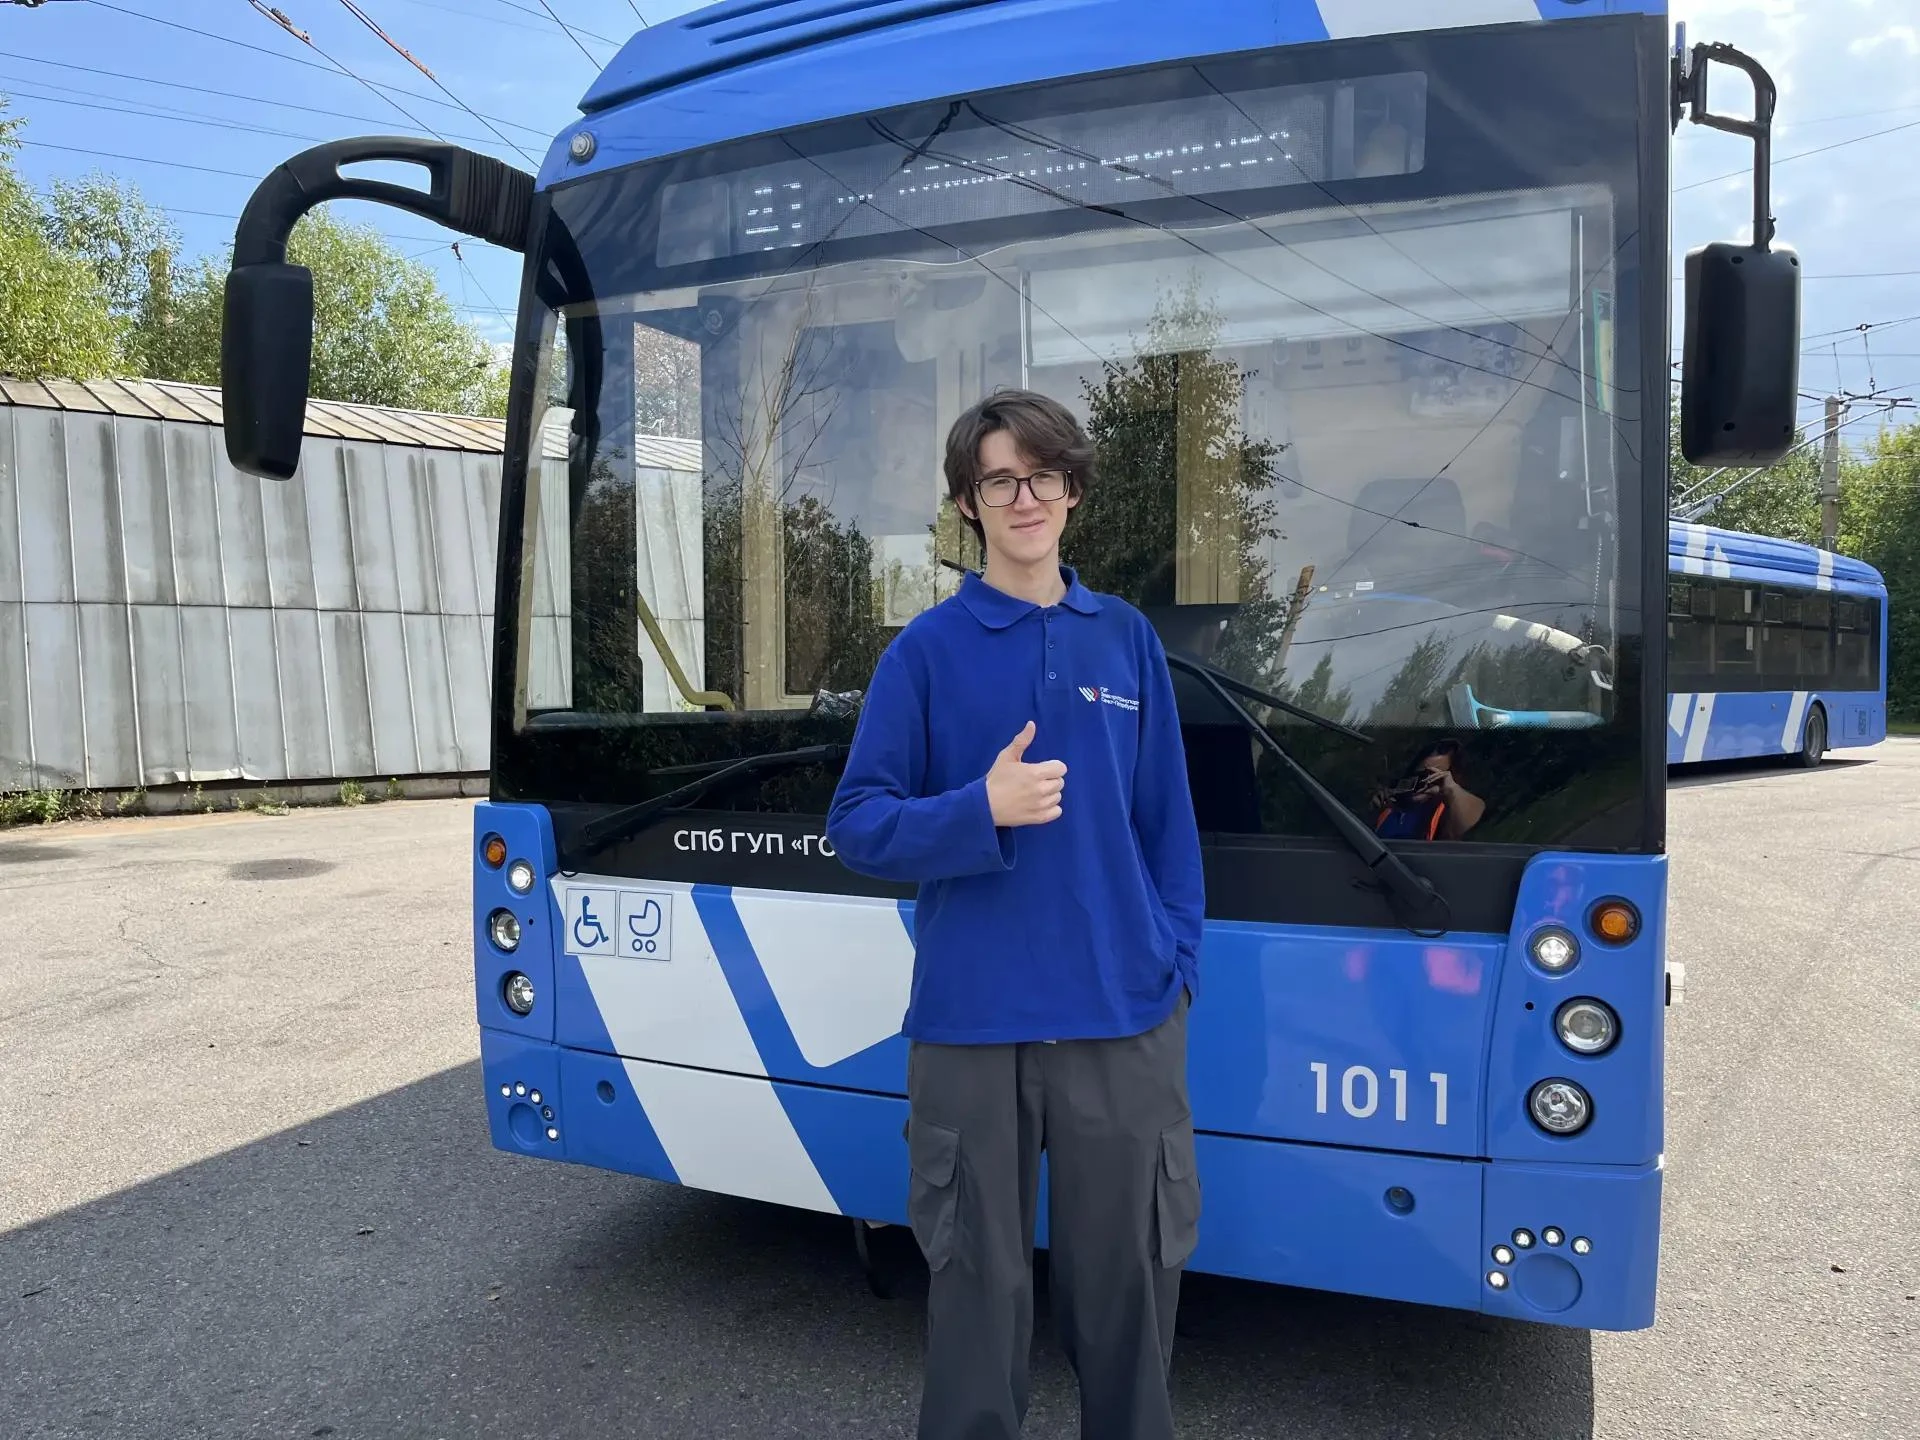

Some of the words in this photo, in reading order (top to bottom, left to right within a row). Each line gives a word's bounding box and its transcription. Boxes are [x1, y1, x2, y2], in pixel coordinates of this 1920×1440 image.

[673, 828, 724, 852] СПб
[731, 832, 784, 855] ГУП
[791, 834, 836, 857] «ГО
[1310, 1062, 1448, 1125] 1011
